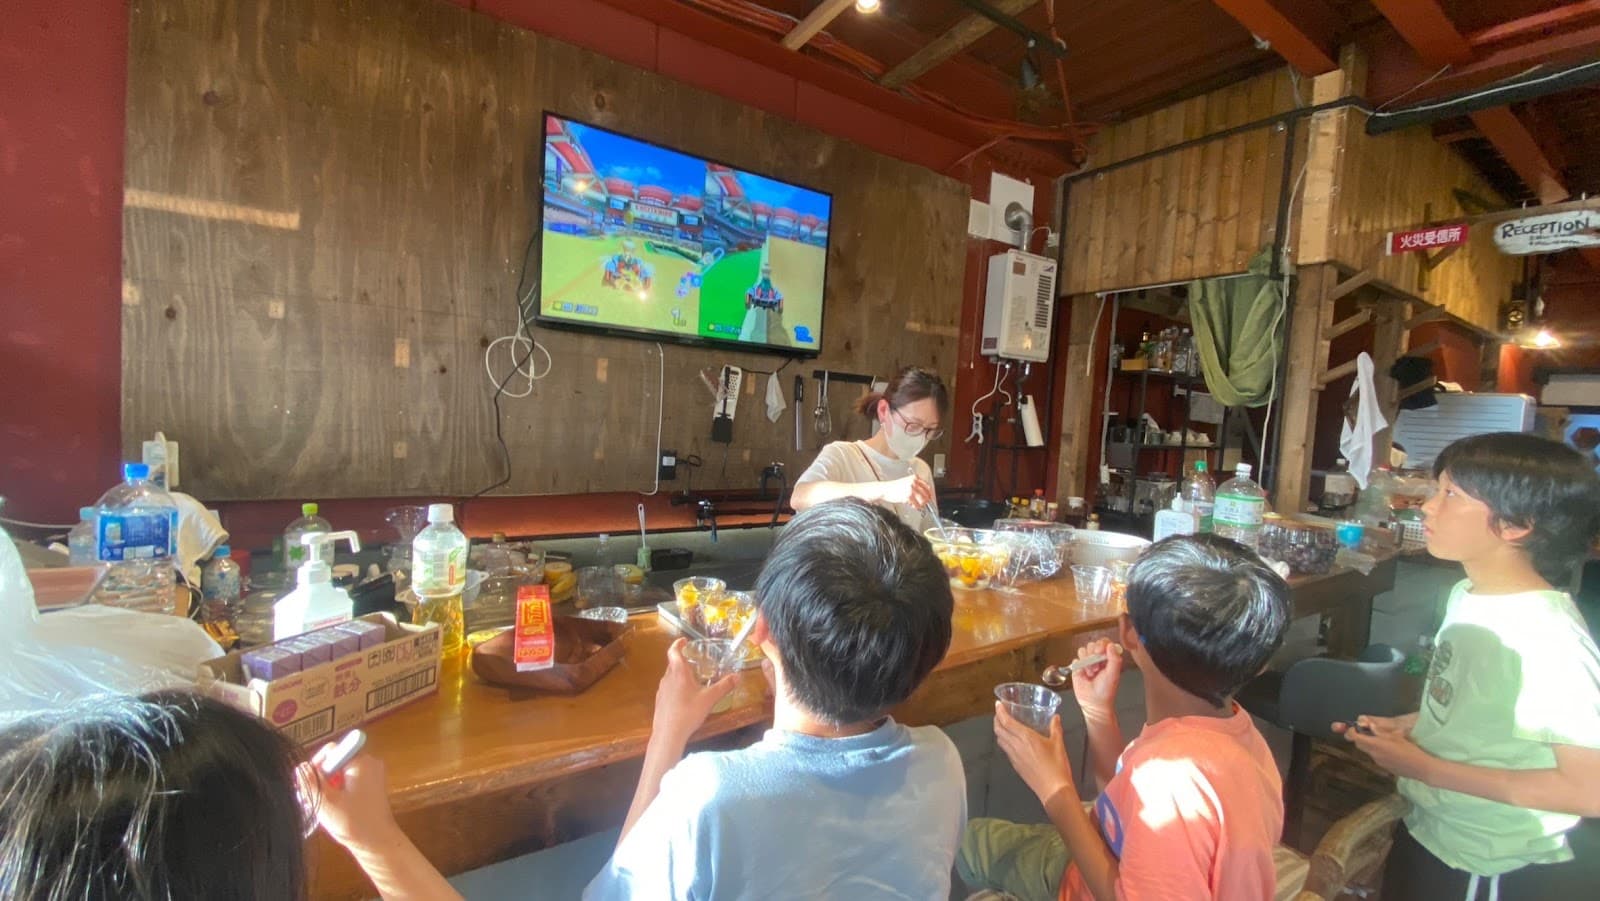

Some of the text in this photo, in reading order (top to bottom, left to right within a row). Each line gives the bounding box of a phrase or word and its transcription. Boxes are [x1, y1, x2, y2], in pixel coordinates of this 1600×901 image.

[1400, 227, 1462, 248] 火災受信所
[1502, 217, 1590, 239] RECEPTION
